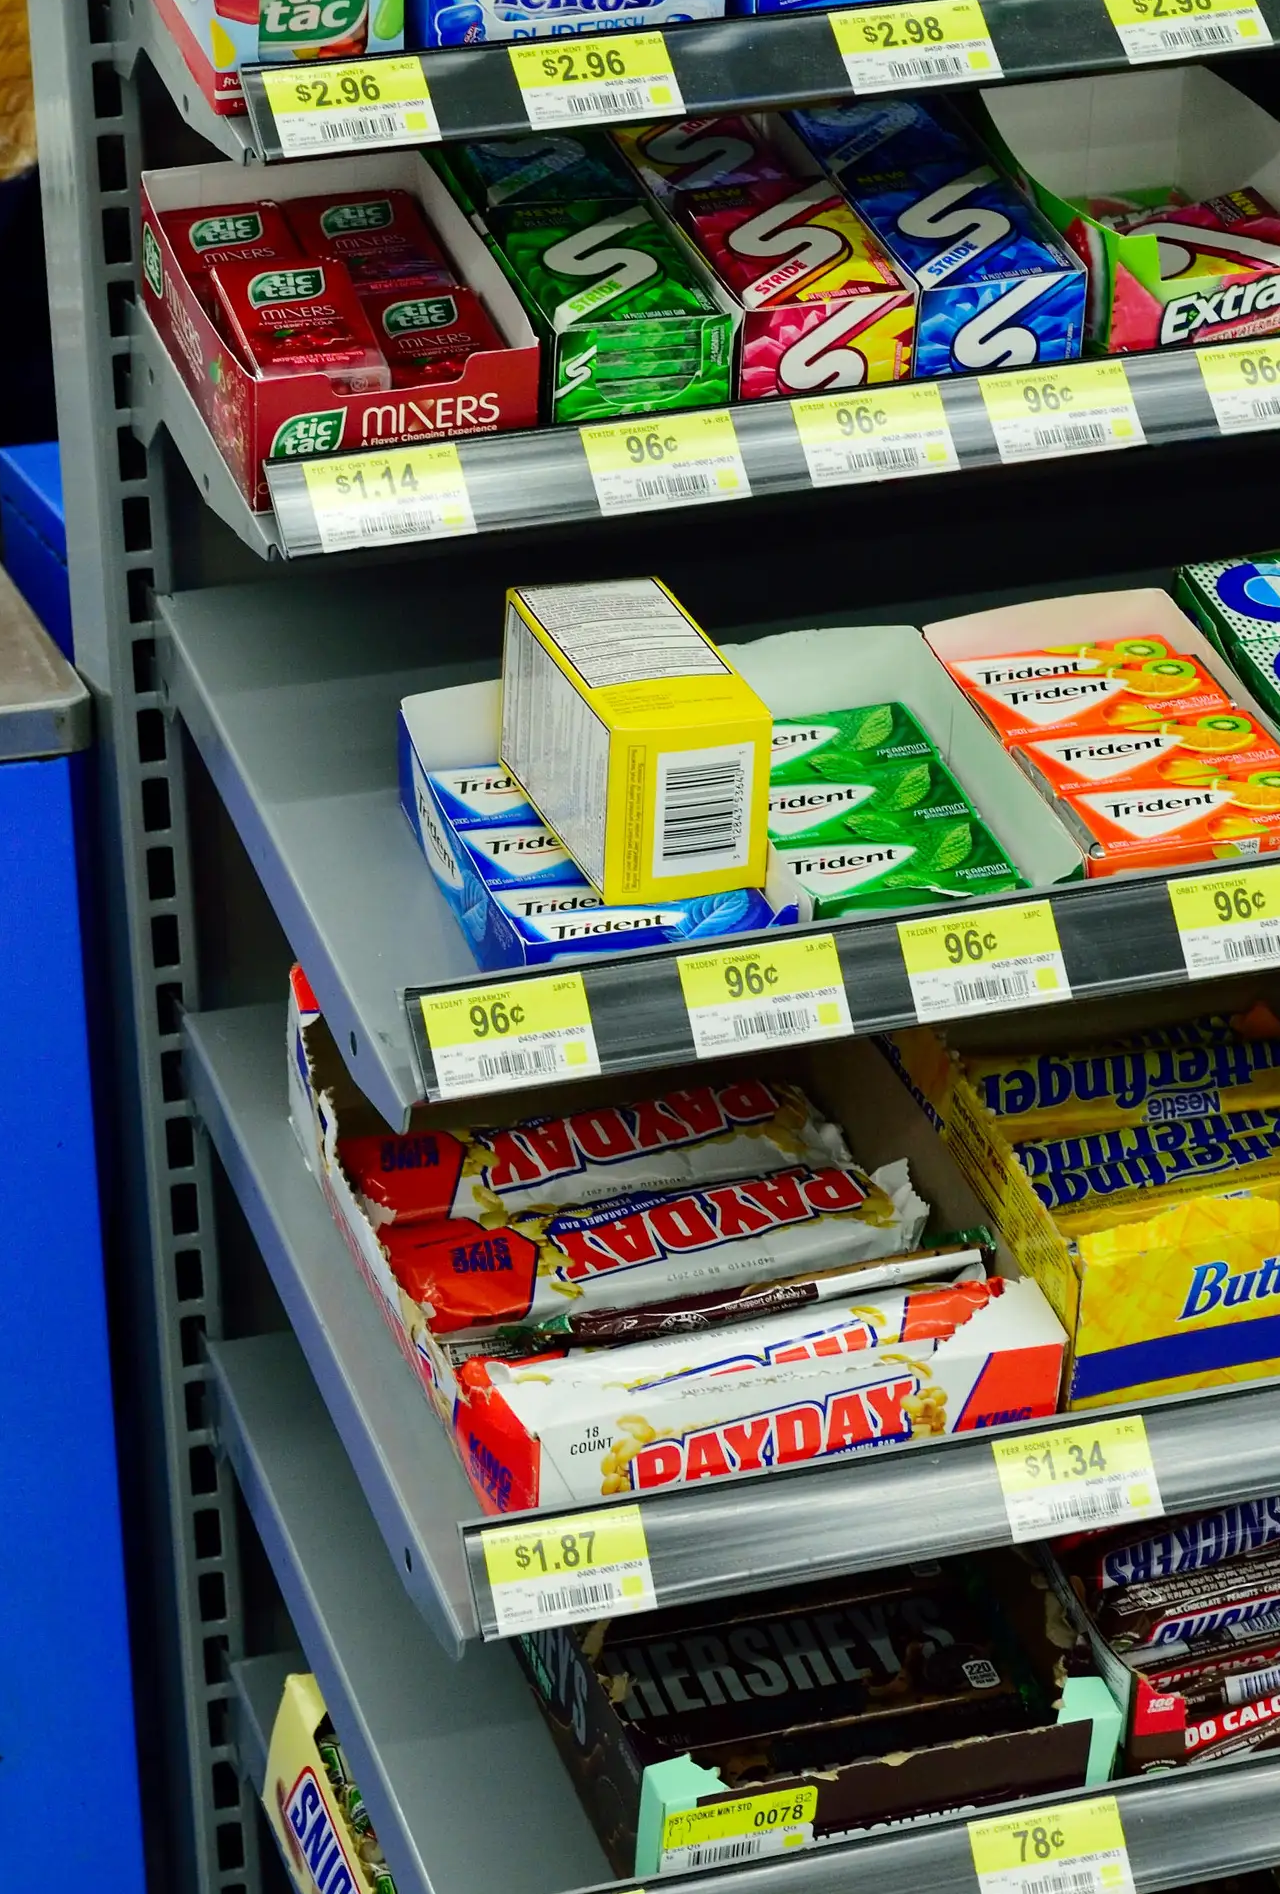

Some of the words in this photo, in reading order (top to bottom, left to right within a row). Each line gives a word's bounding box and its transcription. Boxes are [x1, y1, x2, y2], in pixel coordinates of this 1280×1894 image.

[862, 18, 944, 46] $2.98
[542, 48, 627, 83] $2.96
[295, 74, 382, 108] $2.96
[926, 240, 979, 278] STRIDE
[753, 259, 807, 294] STRIDE
[567, 277, 623, 313] STRIDE
[362, 392, 501, 438] MIXERS
[1022, 385, 1074, 414] 96¢
[835, 407, 889, 437] 96¢
[625, 434, 679, 464] 96¢
[336, 463, 419, 498] $1.14
[977, 660, 1083, 686] Trident
[1003, 679, 1111, 707] Trident
[1056, 735, 1166, 763] Trident
[1104, 792, 1215, 819] Trident
[787, 846, 898, 876] Trident
[1213, 888, 1266, 922] 96¢
[552, 910, 667, 940] Trident
[944, 930, 998, 964] 96¢
[724, 962, 778, 998] 96¢
[470, 1002, 525, 1038] 96¢
[570, 1436, 615, 1458] COUNT
[584, 1426, 600, 1441] 18
[627, 1379, 916, 1490] PAYDAY
[1024, 1439, 1107, 1479] $1.34
[513, 1530, 598, 1571] $1.87
[754, 1805, 804, 1827] 0078
[1013, 1827, 1066, 1863] 78¢
